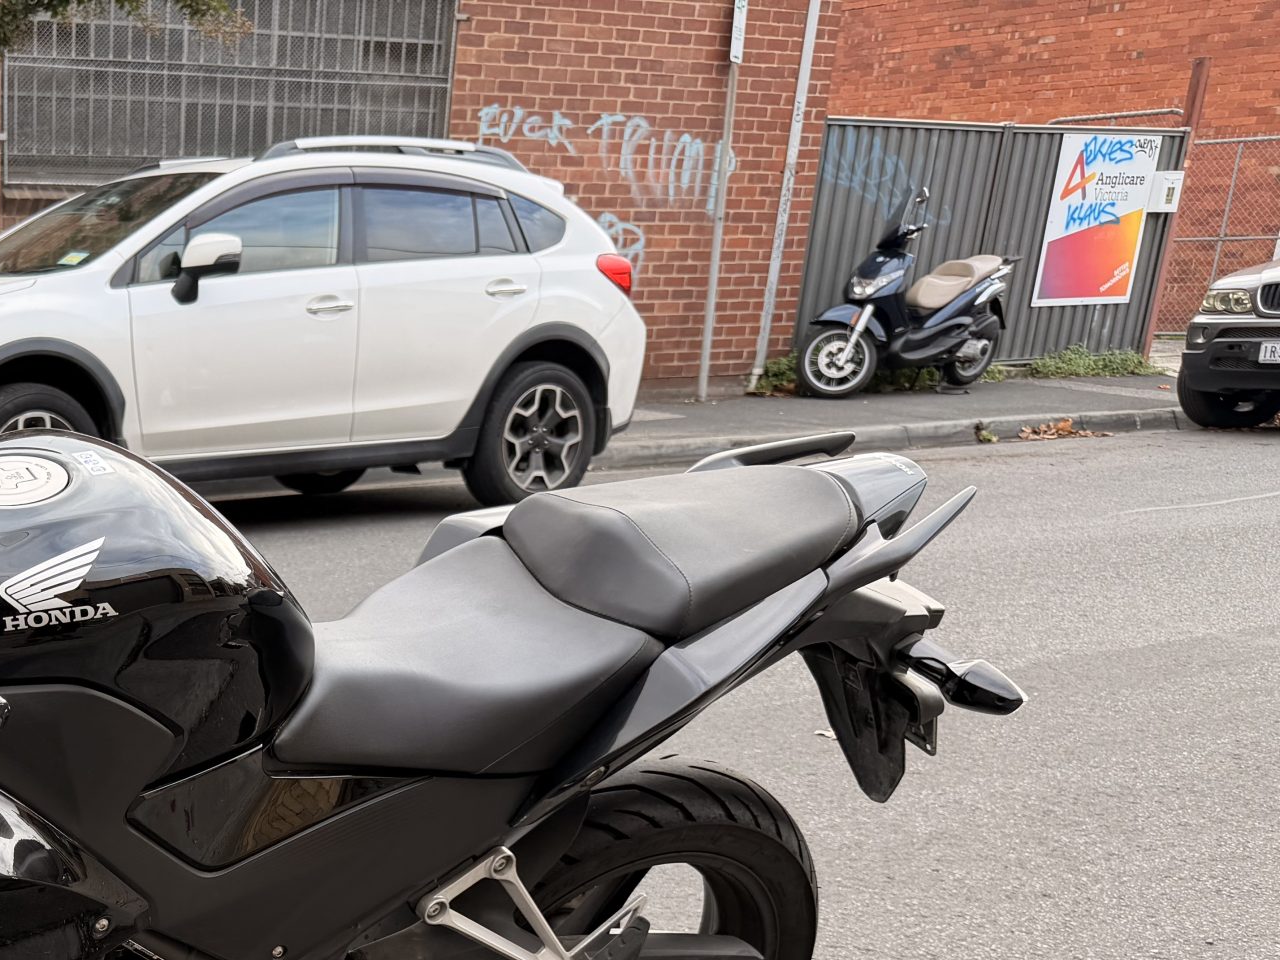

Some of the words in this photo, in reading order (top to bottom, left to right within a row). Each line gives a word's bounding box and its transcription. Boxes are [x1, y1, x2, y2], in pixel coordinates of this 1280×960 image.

[1095, 172, 1146, 189] Anglicare
[1094, 187, 1129, 201] Victoria
[2, 602, 119, 632] HONDA
